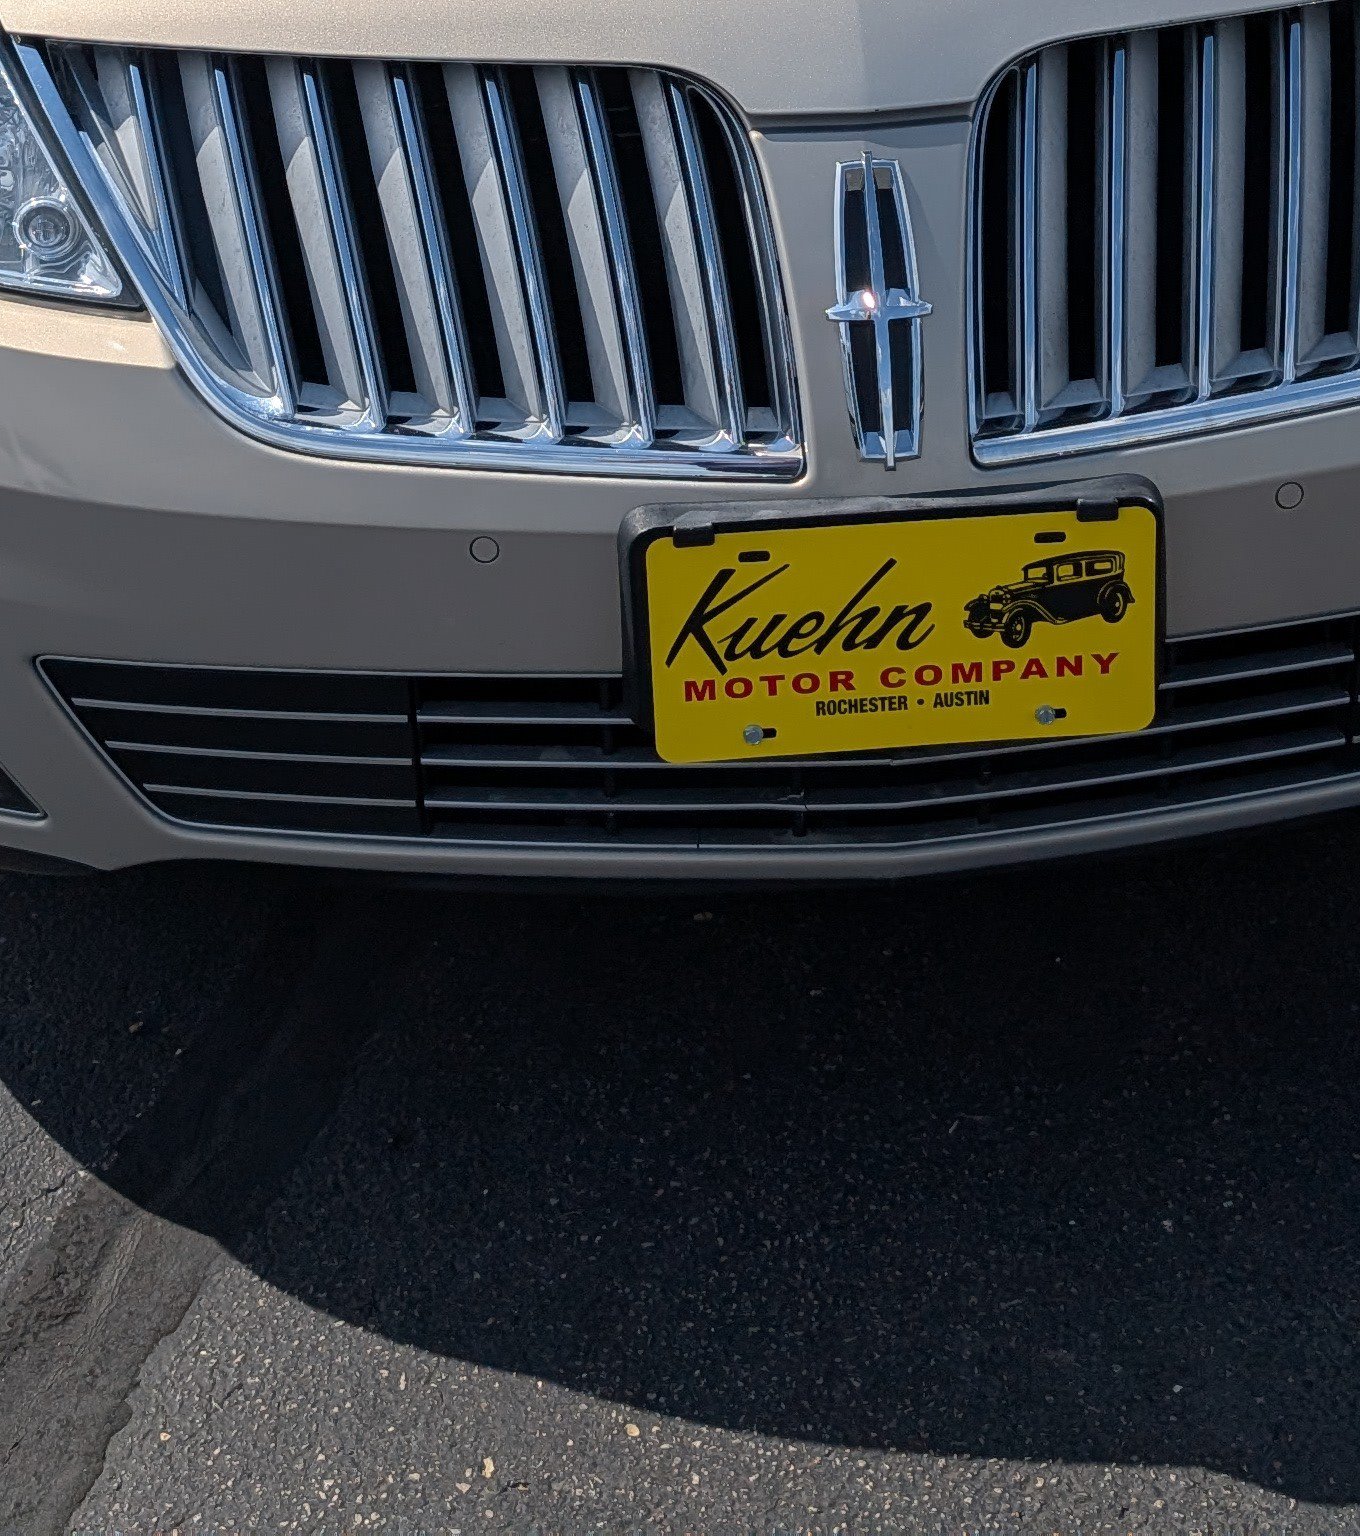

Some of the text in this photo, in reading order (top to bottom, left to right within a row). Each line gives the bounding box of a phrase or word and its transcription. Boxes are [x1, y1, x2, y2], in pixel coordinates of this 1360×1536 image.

[665, 558, 936, 676] Kuehn
[684, 652, 1120, 702] MOTOR COMPANY
[815, 690, 990, 716] ROCHESTER AUSTIN
